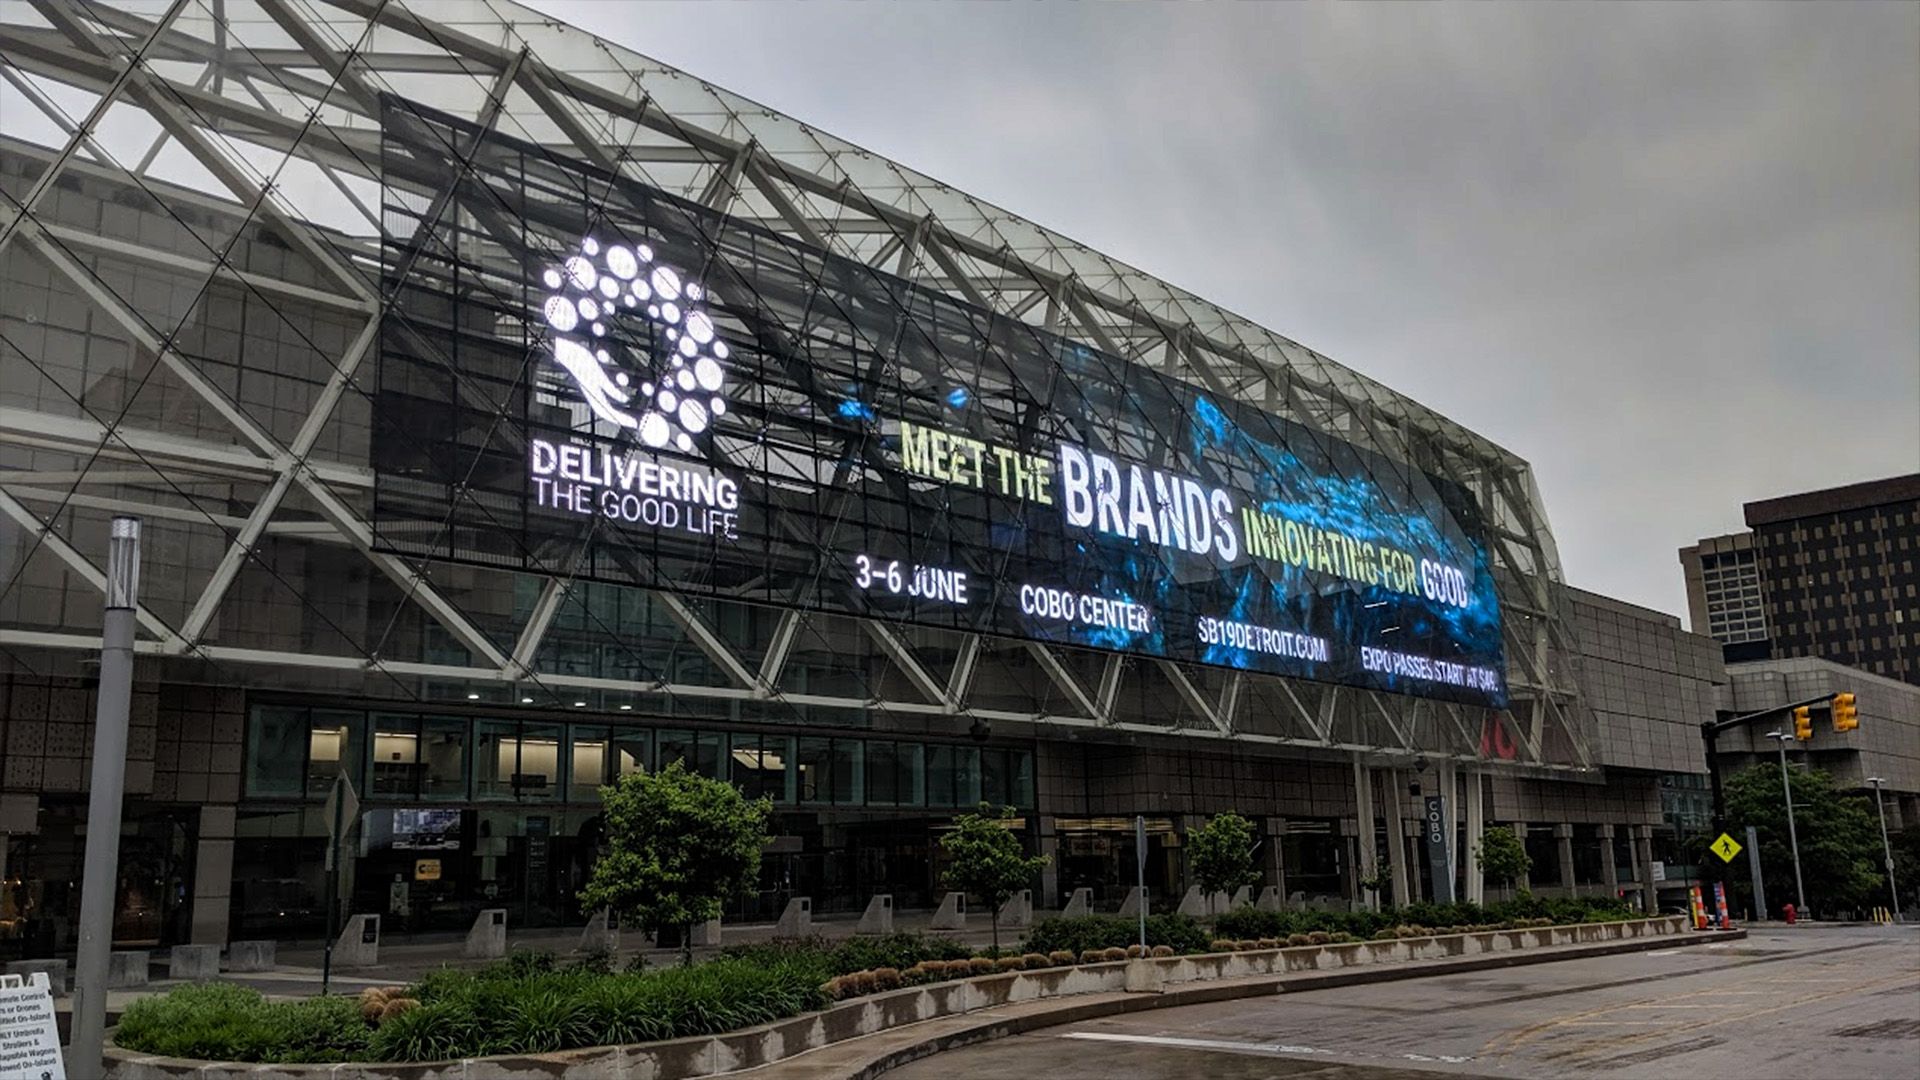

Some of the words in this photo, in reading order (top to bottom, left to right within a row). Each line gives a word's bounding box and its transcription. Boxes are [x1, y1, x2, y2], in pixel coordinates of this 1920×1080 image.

[532, 440, 739, 510] DELIVERING
[900, 420, 987, 489] MEET
[993, 445, 1053, 505] THE
[531, 476, 593, 514] THE
[600, 490, 679, 530] GOOD
[687, 509, 739, 541] LIFE
[1060, 443, 1238, 563] BRANDS
[1241, 506, 1378, 586] INNOVATING
[1380, 545, 1420, 598] FOR
[1421, 557, 1468, 609] GOOD
[907, 564, 969, 605] JUNE
[1020, 584, 1076, 622] COBO
[1079, 594, 1151, 634] CENTER
[1198, 616, 1328, 663] SB19DETROIT.COM
[1360, 645, 1392, 674] EXPO
[1393, 651, 1434, 681] PASSES
[1433, 659, 1465, 686] START
[1466, 666, 1478, 689] AT
[1429, 800, 1442, 843] COBO
[16, 1004, 41, 1013] Drones
